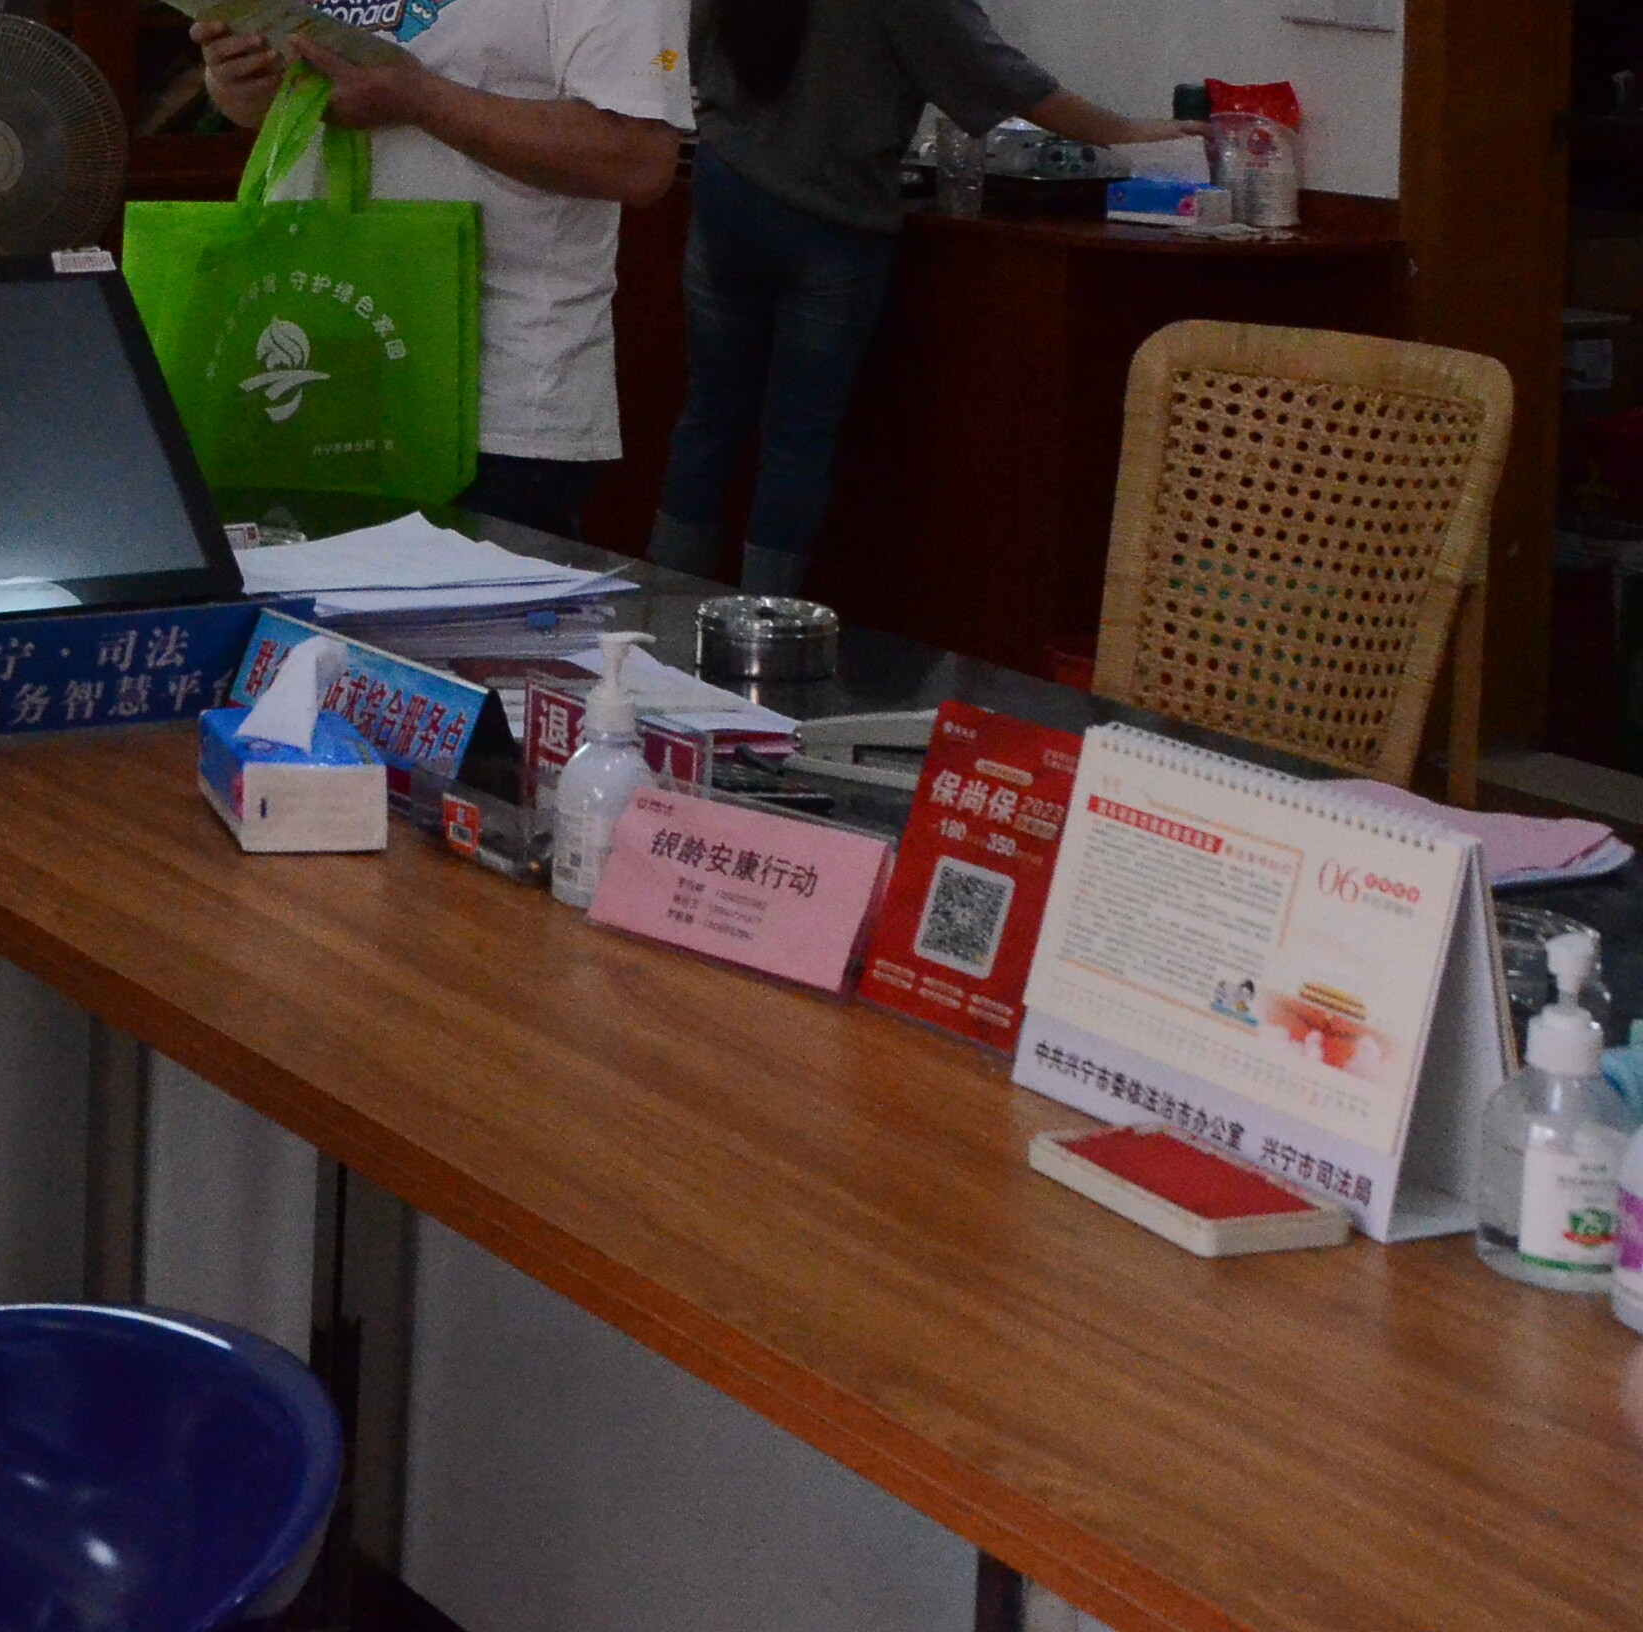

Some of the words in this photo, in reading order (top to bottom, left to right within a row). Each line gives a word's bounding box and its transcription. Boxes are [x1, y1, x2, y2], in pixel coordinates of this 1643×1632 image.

[930, 769, 1019, 825] 保尚保
[650, 828, 819, 898] 银龄安康行动
[1318, 858, 1359, 904] 06
[1260, 1137, 1373, 1208] 兴宁市司法局
